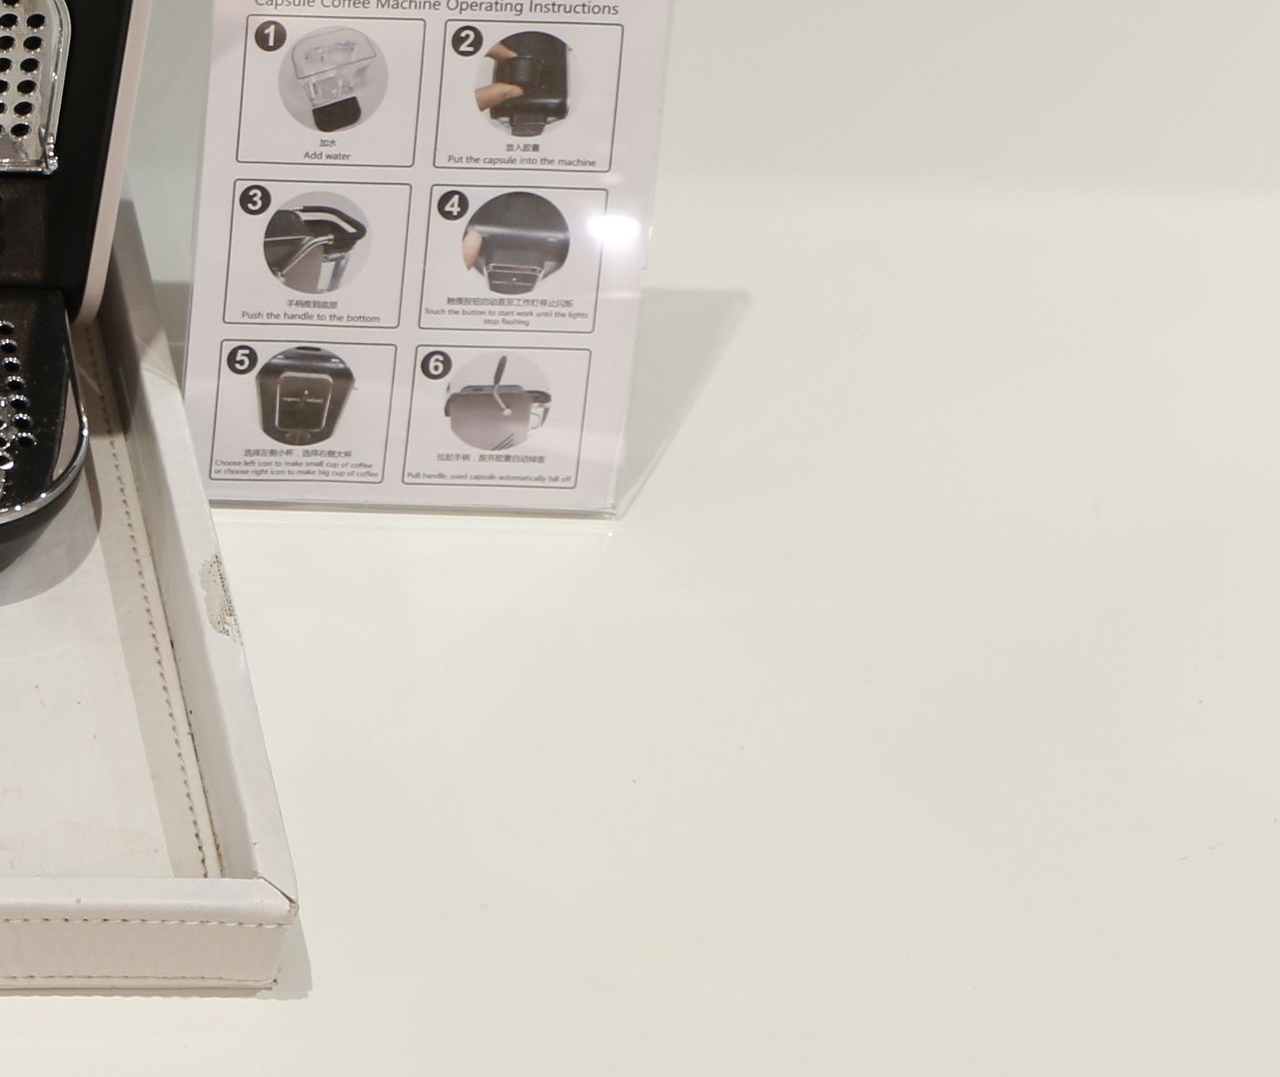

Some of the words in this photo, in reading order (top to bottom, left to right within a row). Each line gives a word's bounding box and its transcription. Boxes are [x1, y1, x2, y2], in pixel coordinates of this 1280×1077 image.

[529, 0, 619, 15] Instructions
[263, 24, 276, 47] 1
[459, 28, 475, 52] 2
[304, 151, 322, 160] Add
[326, 152, 352, 160] water
[448, 154, 463, 164] Put
[466, 155, 481, 164] the
[482, 155, 517, 166] capsule
[520, 156, 538, 164] into
[540, 156, 556, 165] the
[558, 158, 597, 166] machine
[247, 188, 263, 211] 3
[444, 194, 462, 216] 4
[242, 310, 264, 320] Push
[266, 311, 281, 320] the
[284, 312, 314, 321] handle
[317, 313, 326, 321] to
[329, 312, 344, 322] the
[346, 314, 381, 322] bottom
[448, 308, 460, 316] the
[234, 349, 250, 372] 5
[428, 354, 444, 376] 6
